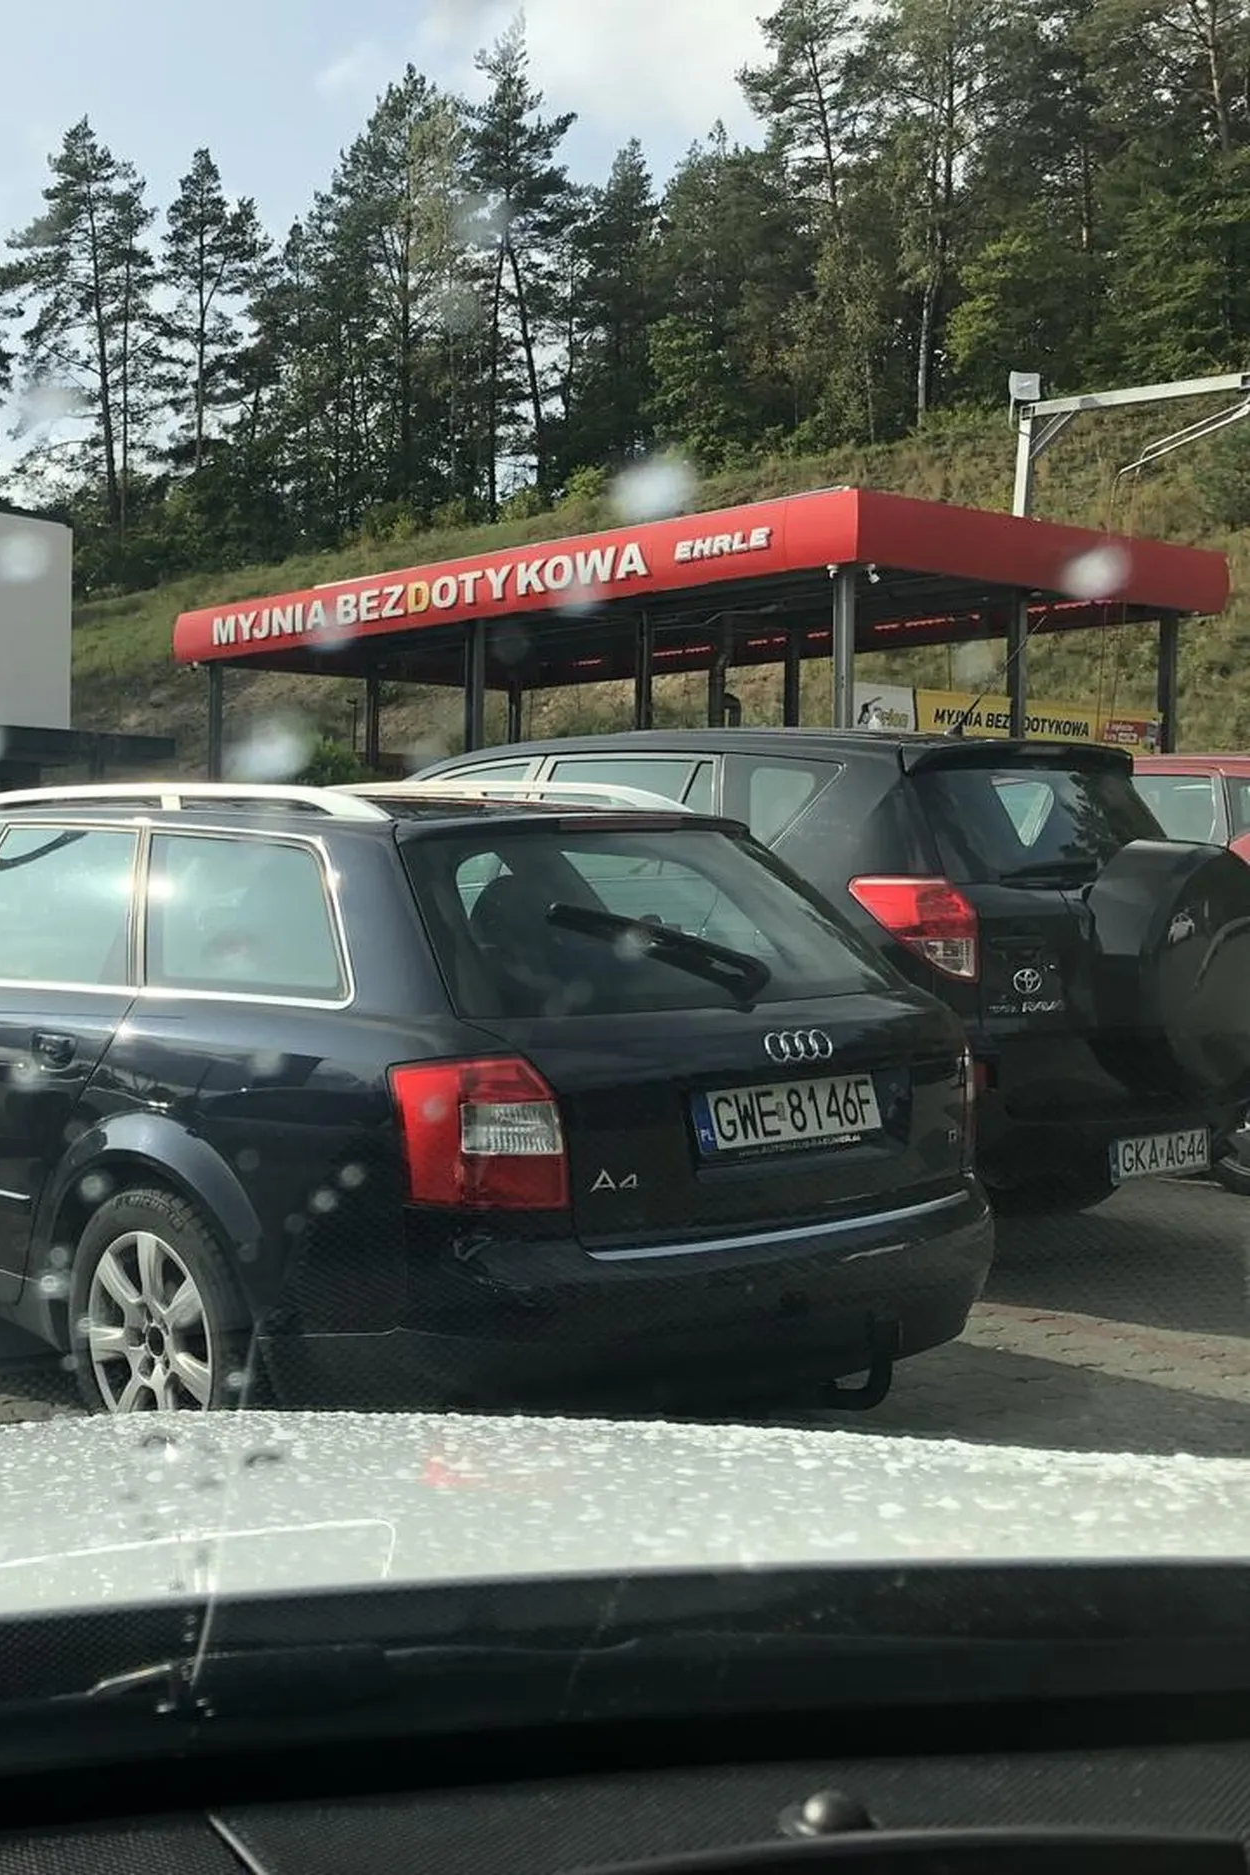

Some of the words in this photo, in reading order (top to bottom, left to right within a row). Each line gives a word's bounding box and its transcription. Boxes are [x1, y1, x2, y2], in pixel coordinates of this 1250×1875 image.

[674, 526, 771, 563] EHRLE
[212, 600, 327, 646] MYJNIA
[336, 542, 649, 626] BEZDOTYKOWA
[713, 1090, 781, 1142] GWE
[786, 1079, 871, 1132] 8146F
[700, 1128, 715, 1143] PL
[590, 1168, 639, 1193] A4
